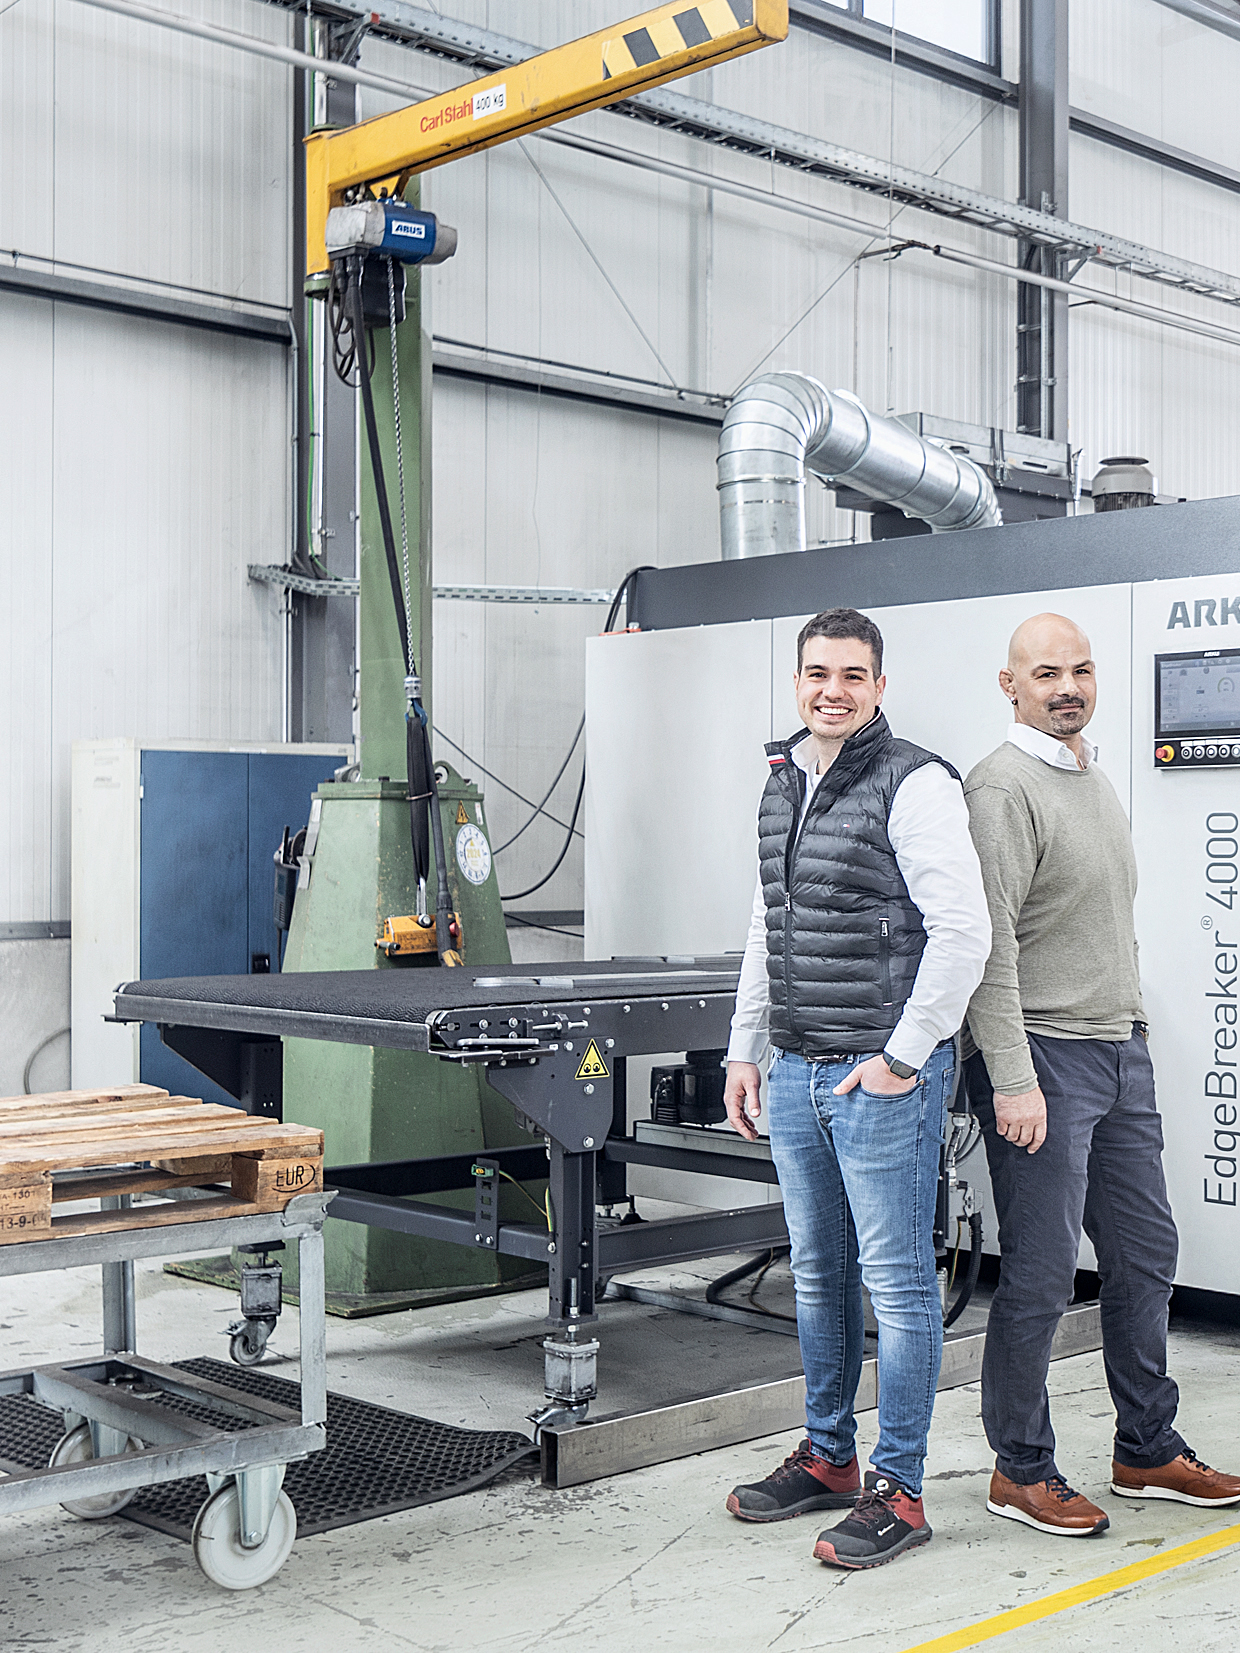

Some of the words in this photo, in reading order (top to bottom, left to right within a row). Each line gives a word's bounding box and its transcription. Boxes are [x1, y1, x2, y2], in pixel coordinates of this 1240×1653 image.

[475, 95, 491, 111] 400
[493, 92, 504, 107] kg
[420, 109, 444, 133] Carl
[444, 97, 474, 124] Stahl
[395, 224, 423, 236] ABUS
[1205, 812, 1239, 911] 4000
[276, 1165, 304, 1187] EUR
